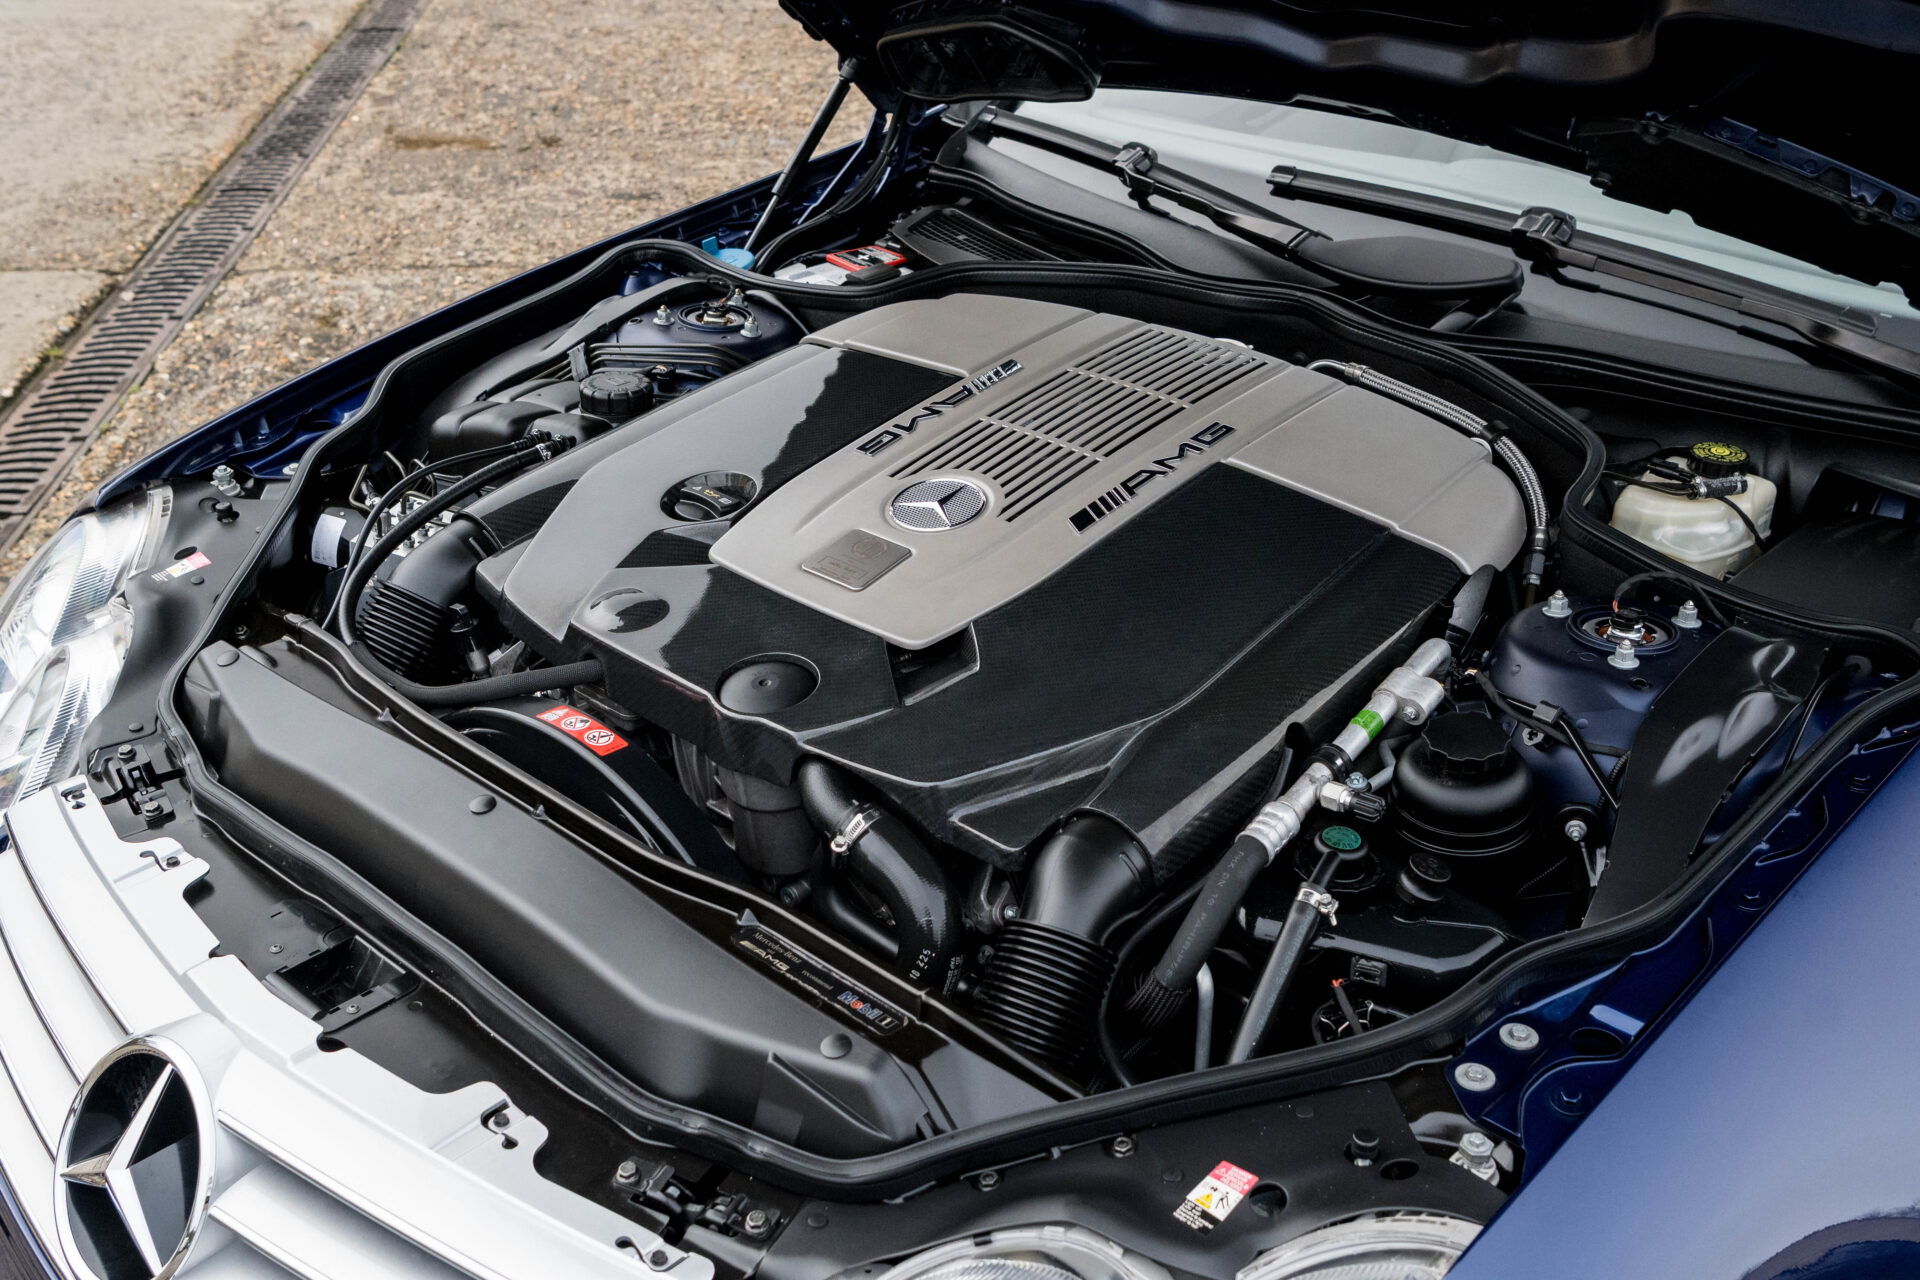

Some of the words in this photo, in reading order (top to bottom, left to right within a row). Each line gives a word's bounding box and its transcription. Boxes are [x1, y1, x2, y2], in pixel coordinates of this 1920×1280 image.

[856, 383, 975, 456] AMG
[1119, 421, 1236, 498] AMG
[753, 931, 803, 964] Mercedes-Benz
[837, 991, 882, 1020] Mobil
